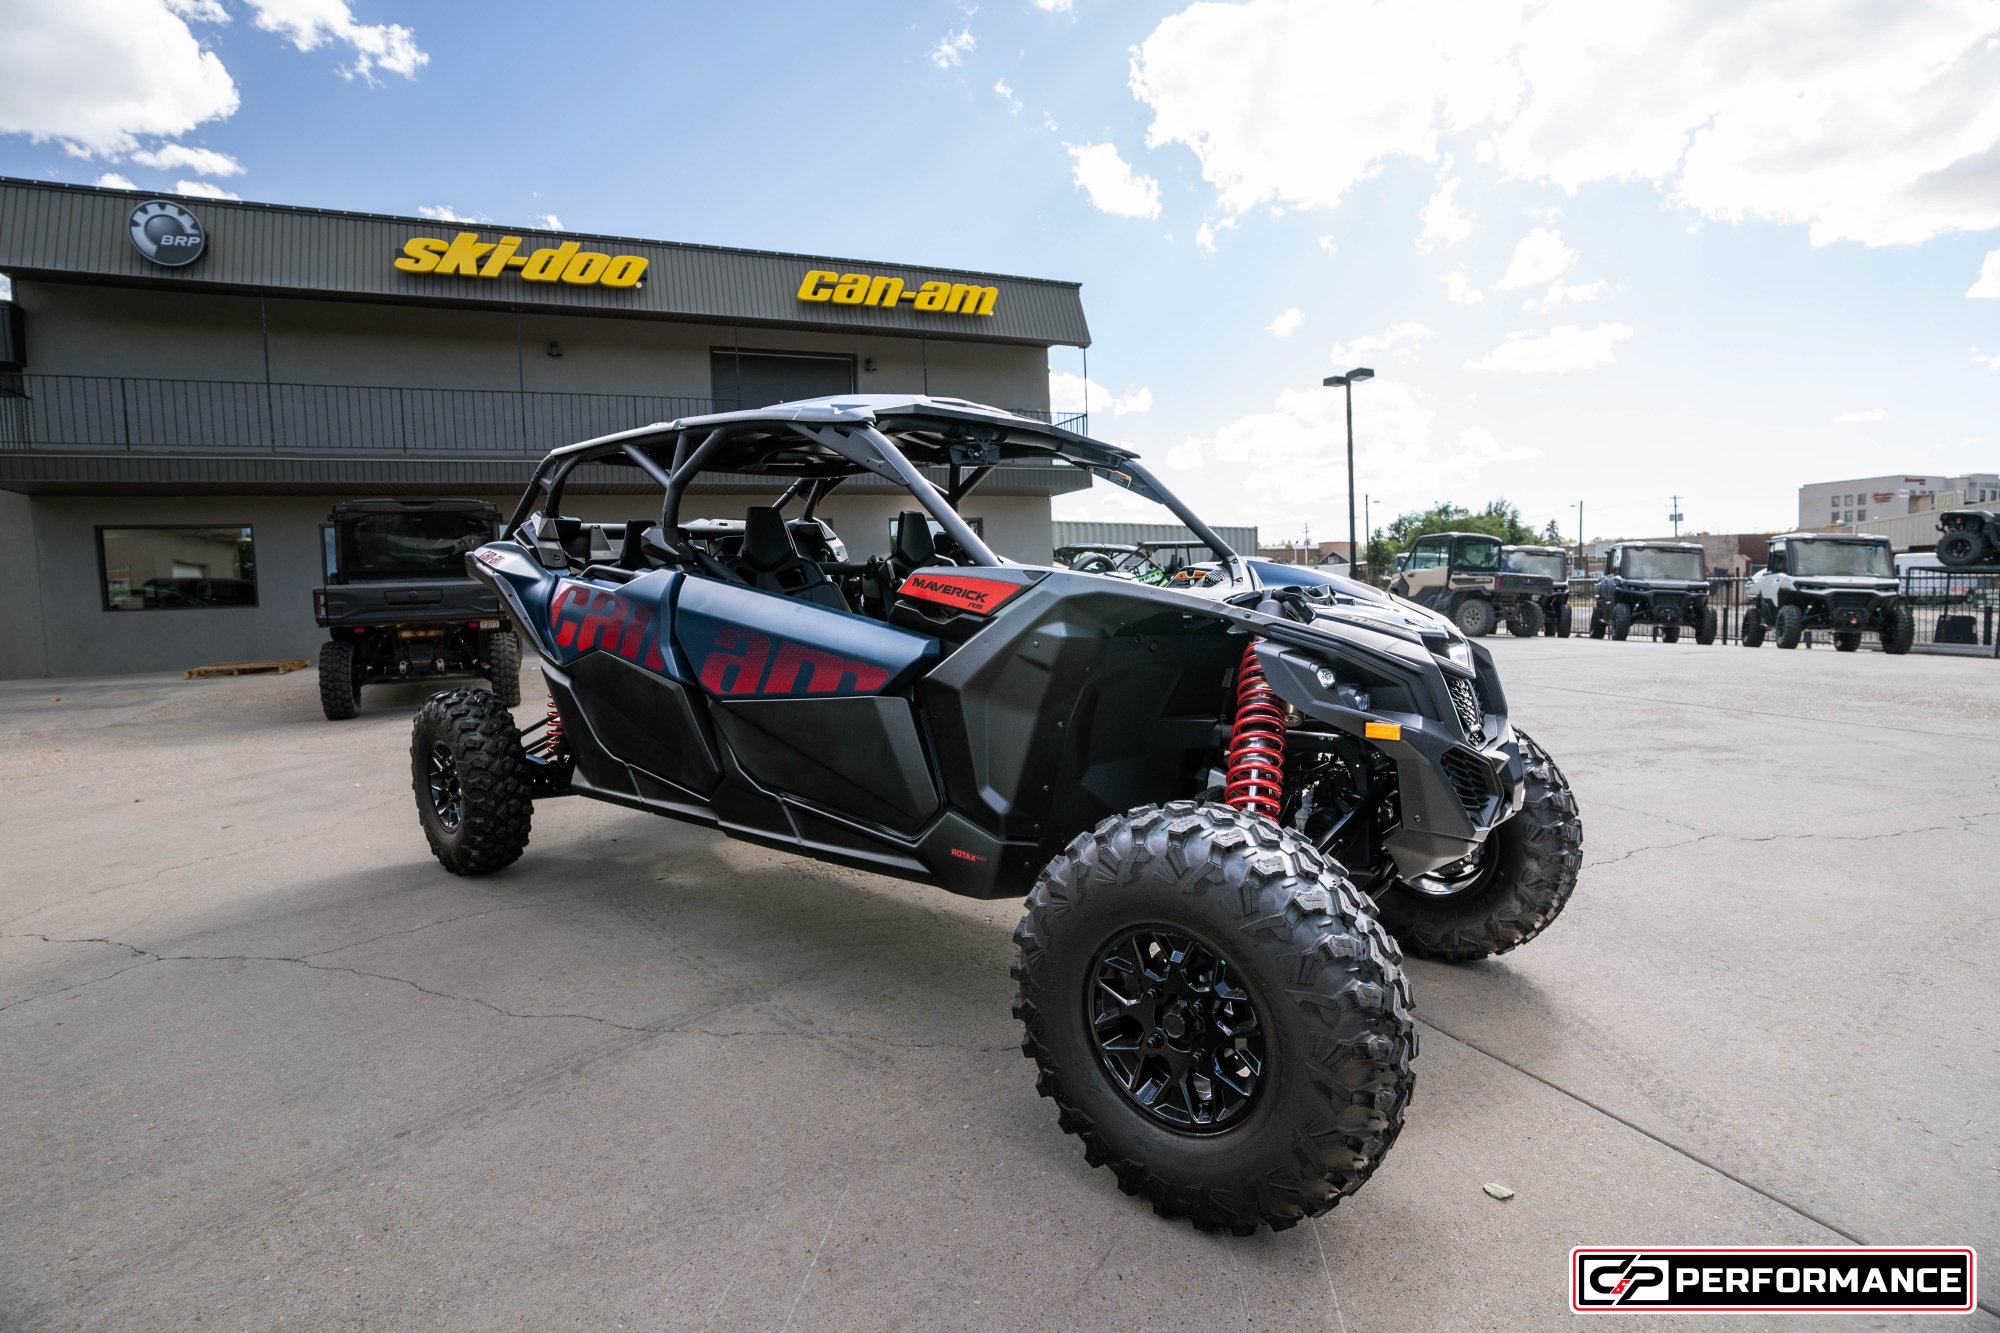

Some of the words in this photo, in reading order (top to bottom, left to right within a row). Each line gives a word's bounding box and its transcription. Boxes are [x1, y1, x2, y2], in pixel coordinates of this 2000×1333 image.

[160, 235, 201, 247] BRP
[394, 232, 649, 289] ski-doo
[797, 270, 998, 316] can-am
[912, 577, 990, 603] MAVERICK
[967, 602, 983, 610] RS
[951, 848, 977, 862] ROTAX
